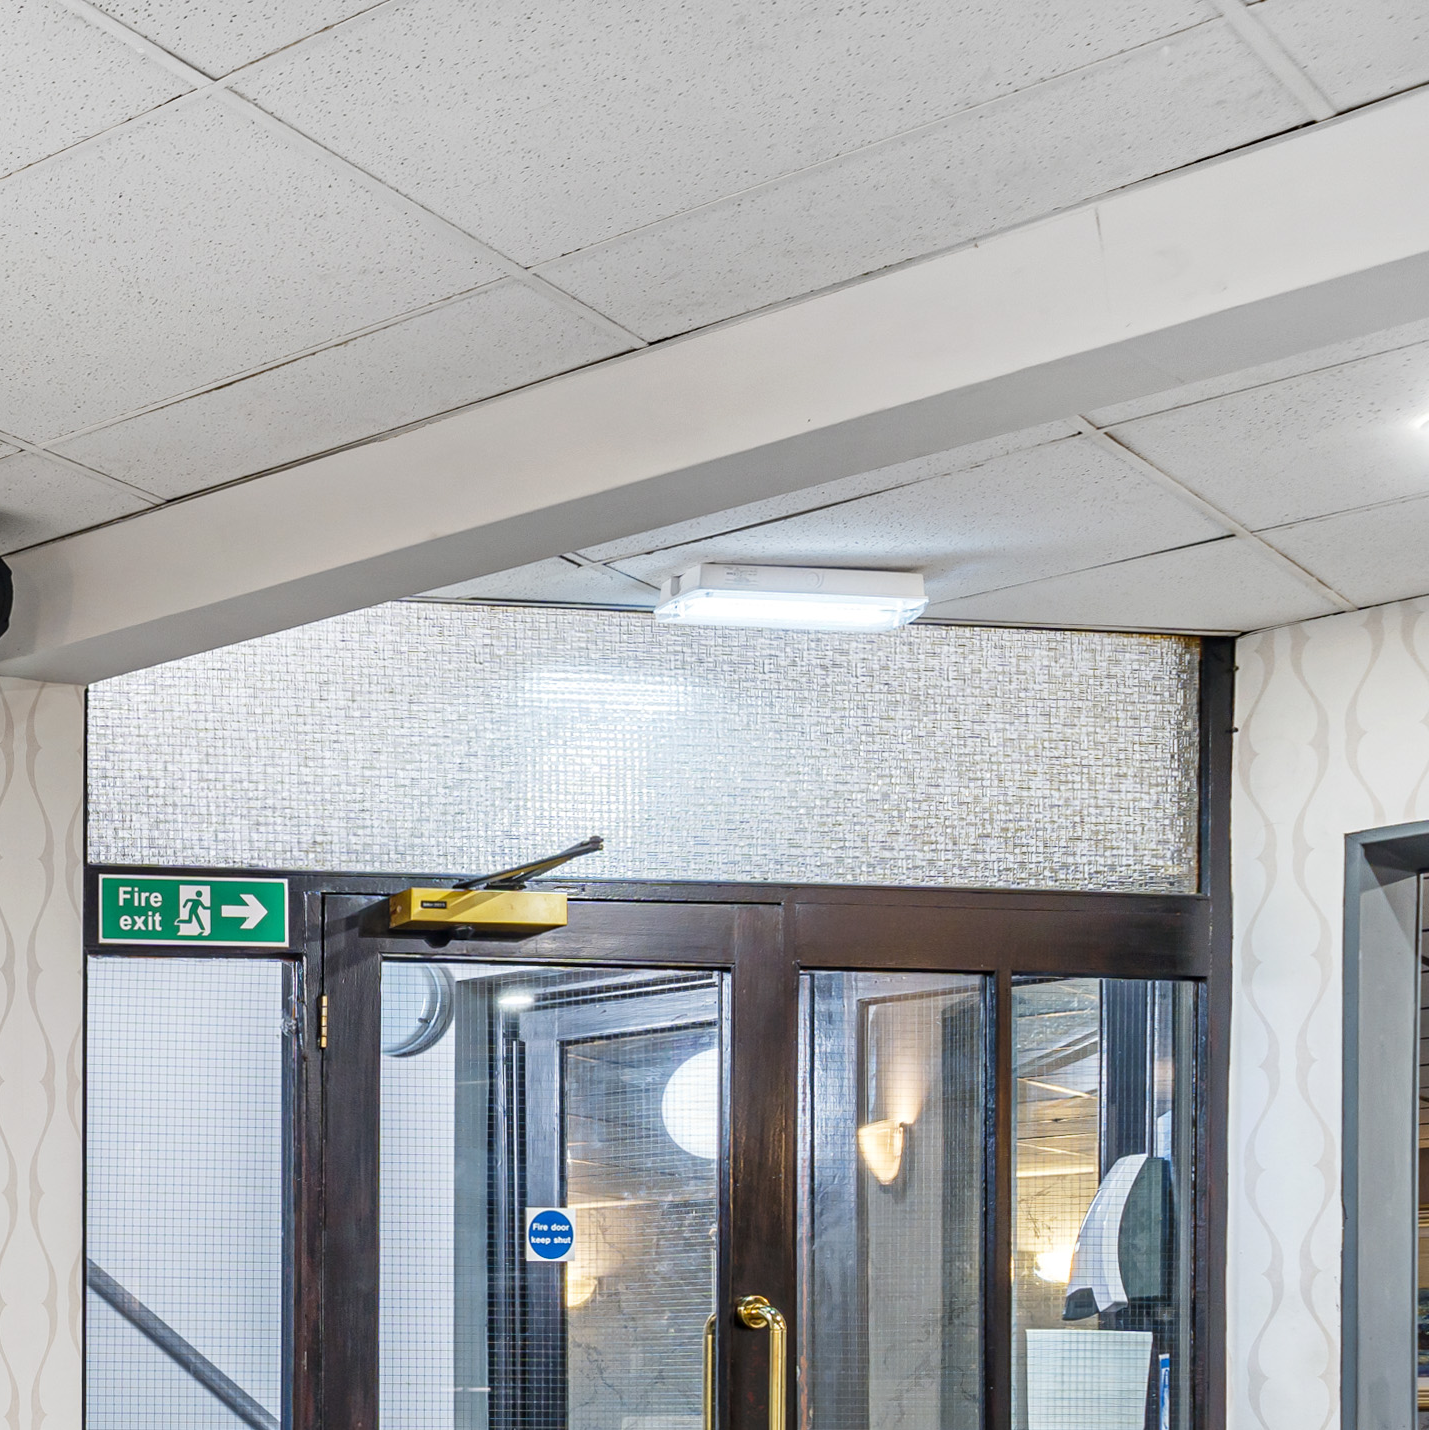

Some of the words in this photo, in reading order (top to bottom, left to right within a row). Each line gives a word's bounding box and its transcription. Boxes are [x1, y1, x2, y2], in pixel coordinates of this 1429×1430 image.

[118, 886, 163, 908] Fire
[118, 910, 163, 932] exit
[532, 1222, 548, 1232] Fire
[550, 1222, 570, 1232] door
[530, 1235, 552, 1246] keep
[553, 1235, 572, 1244] shut
